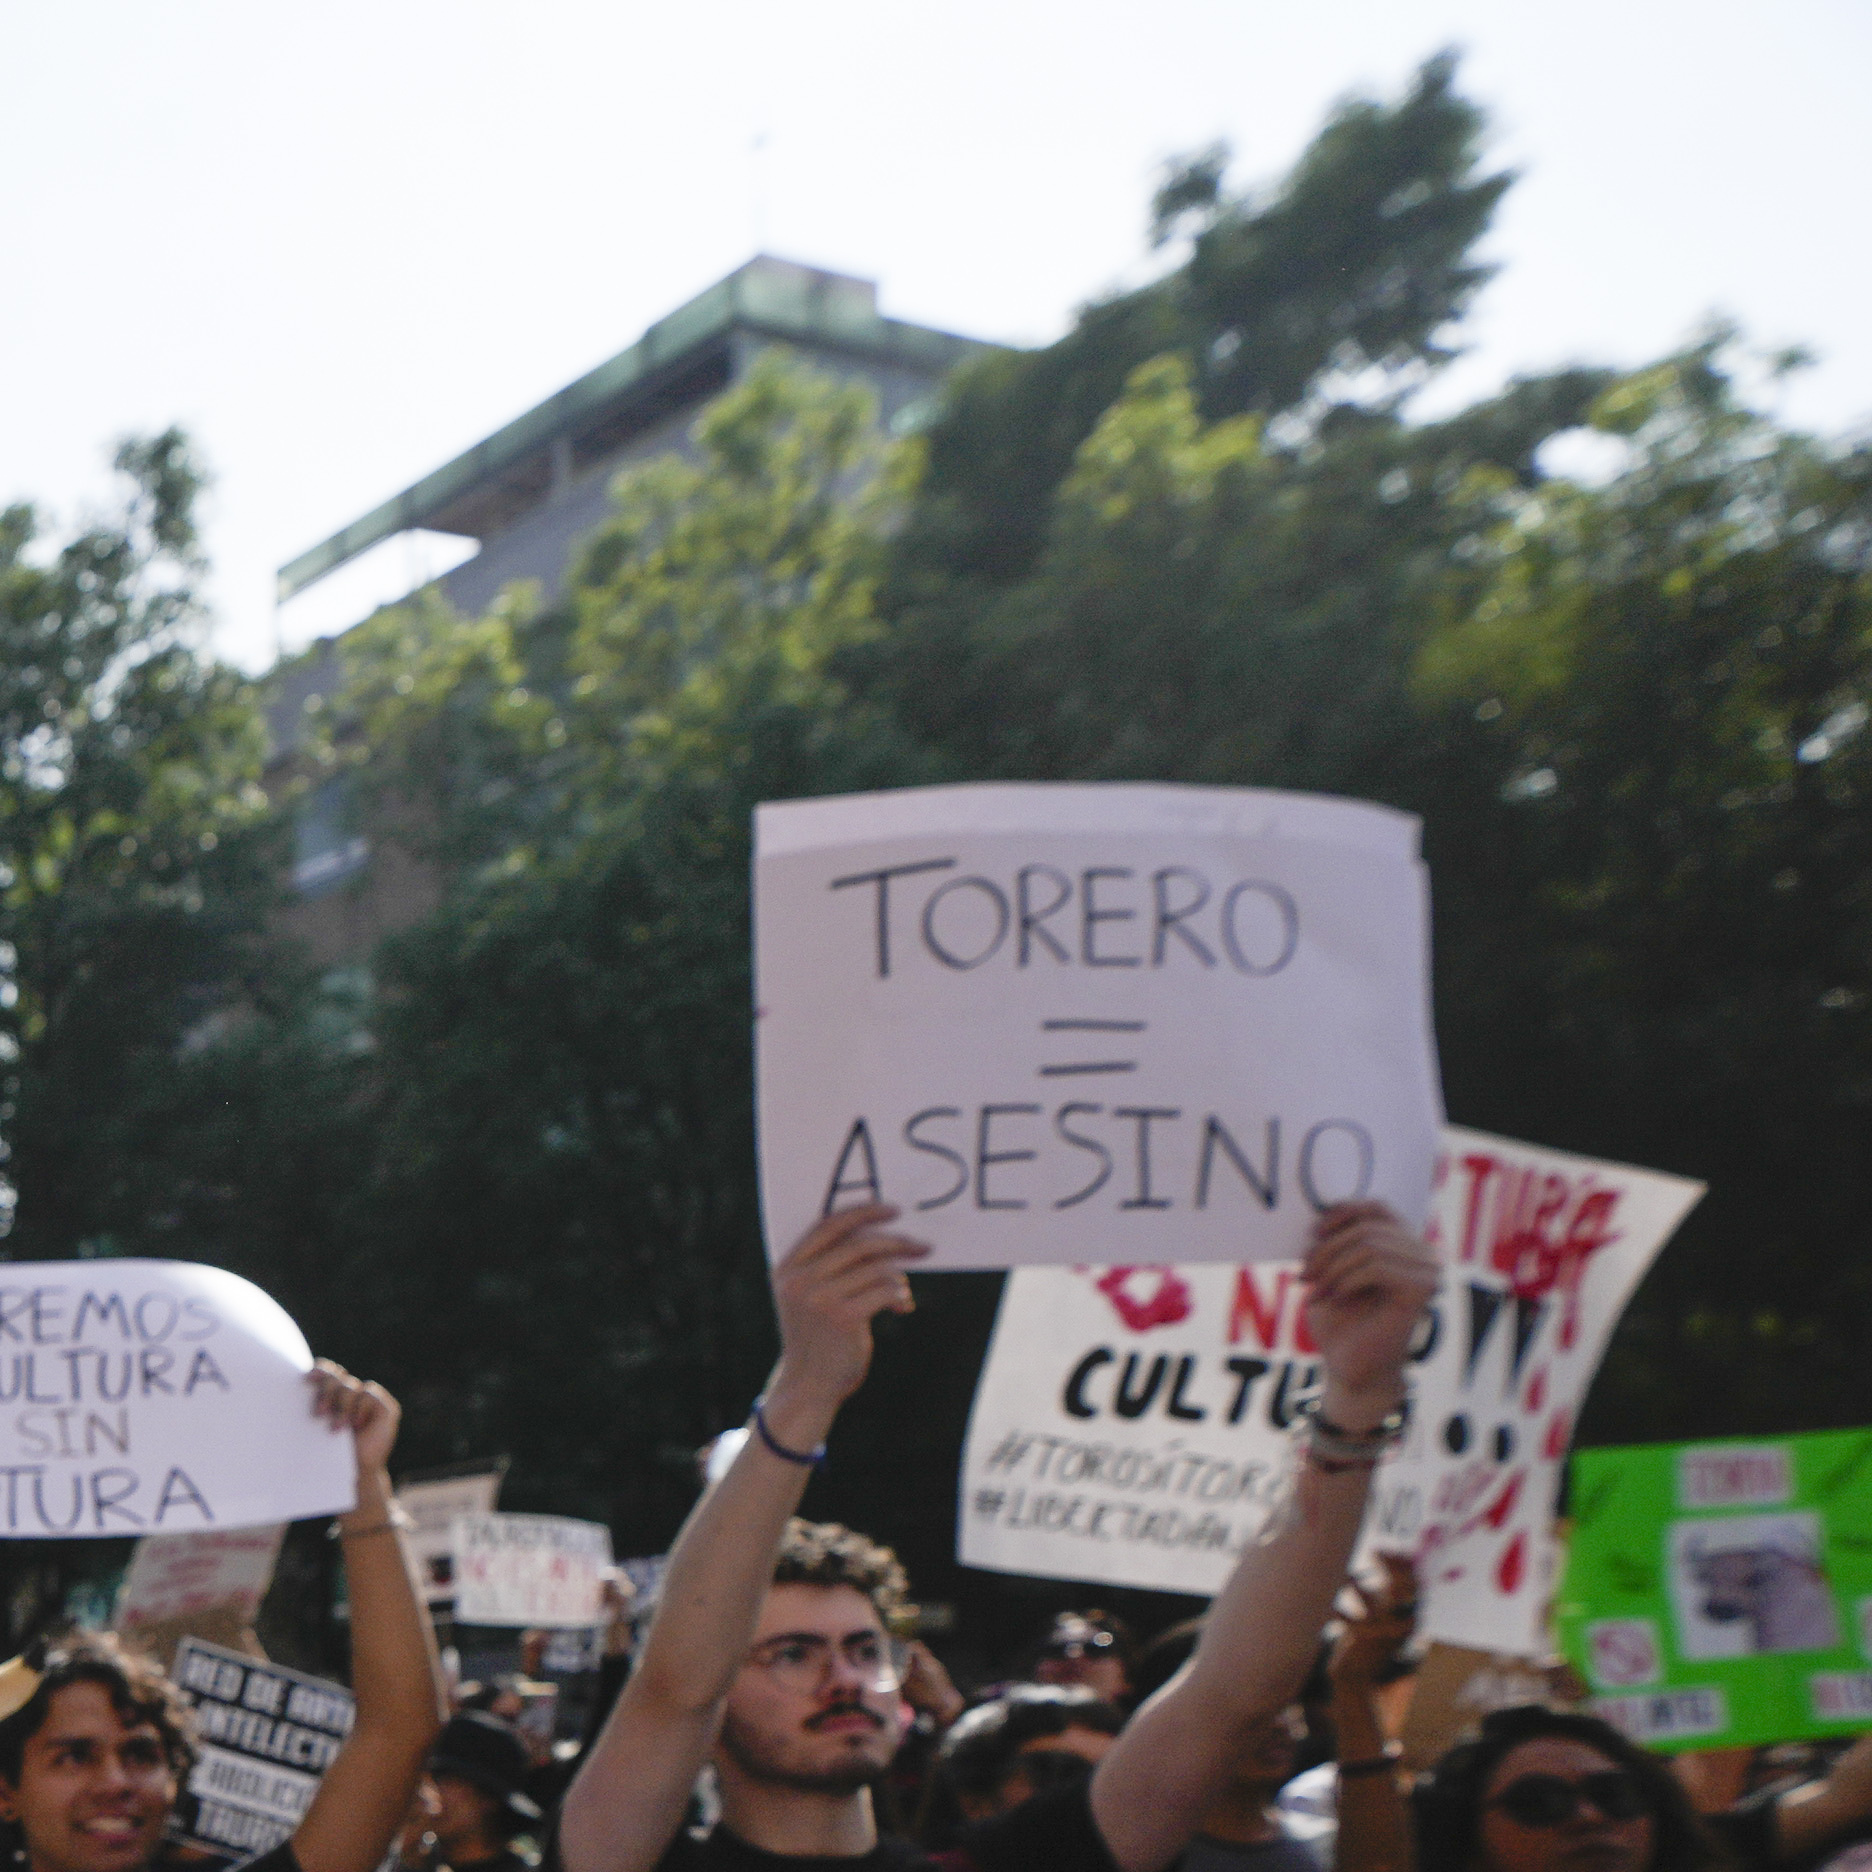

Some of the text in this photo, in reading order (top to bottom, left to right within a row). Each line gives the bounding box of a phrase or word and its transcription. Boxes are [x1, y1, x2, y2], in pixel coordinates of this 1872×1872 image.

[828, 857, 1300, 982] TORERO
[822, 1100, 1376, 1218] ASESINO
[13, 1405, 132, 1460] SIN
[1062, 1343, 1324, 1432] CULTU
